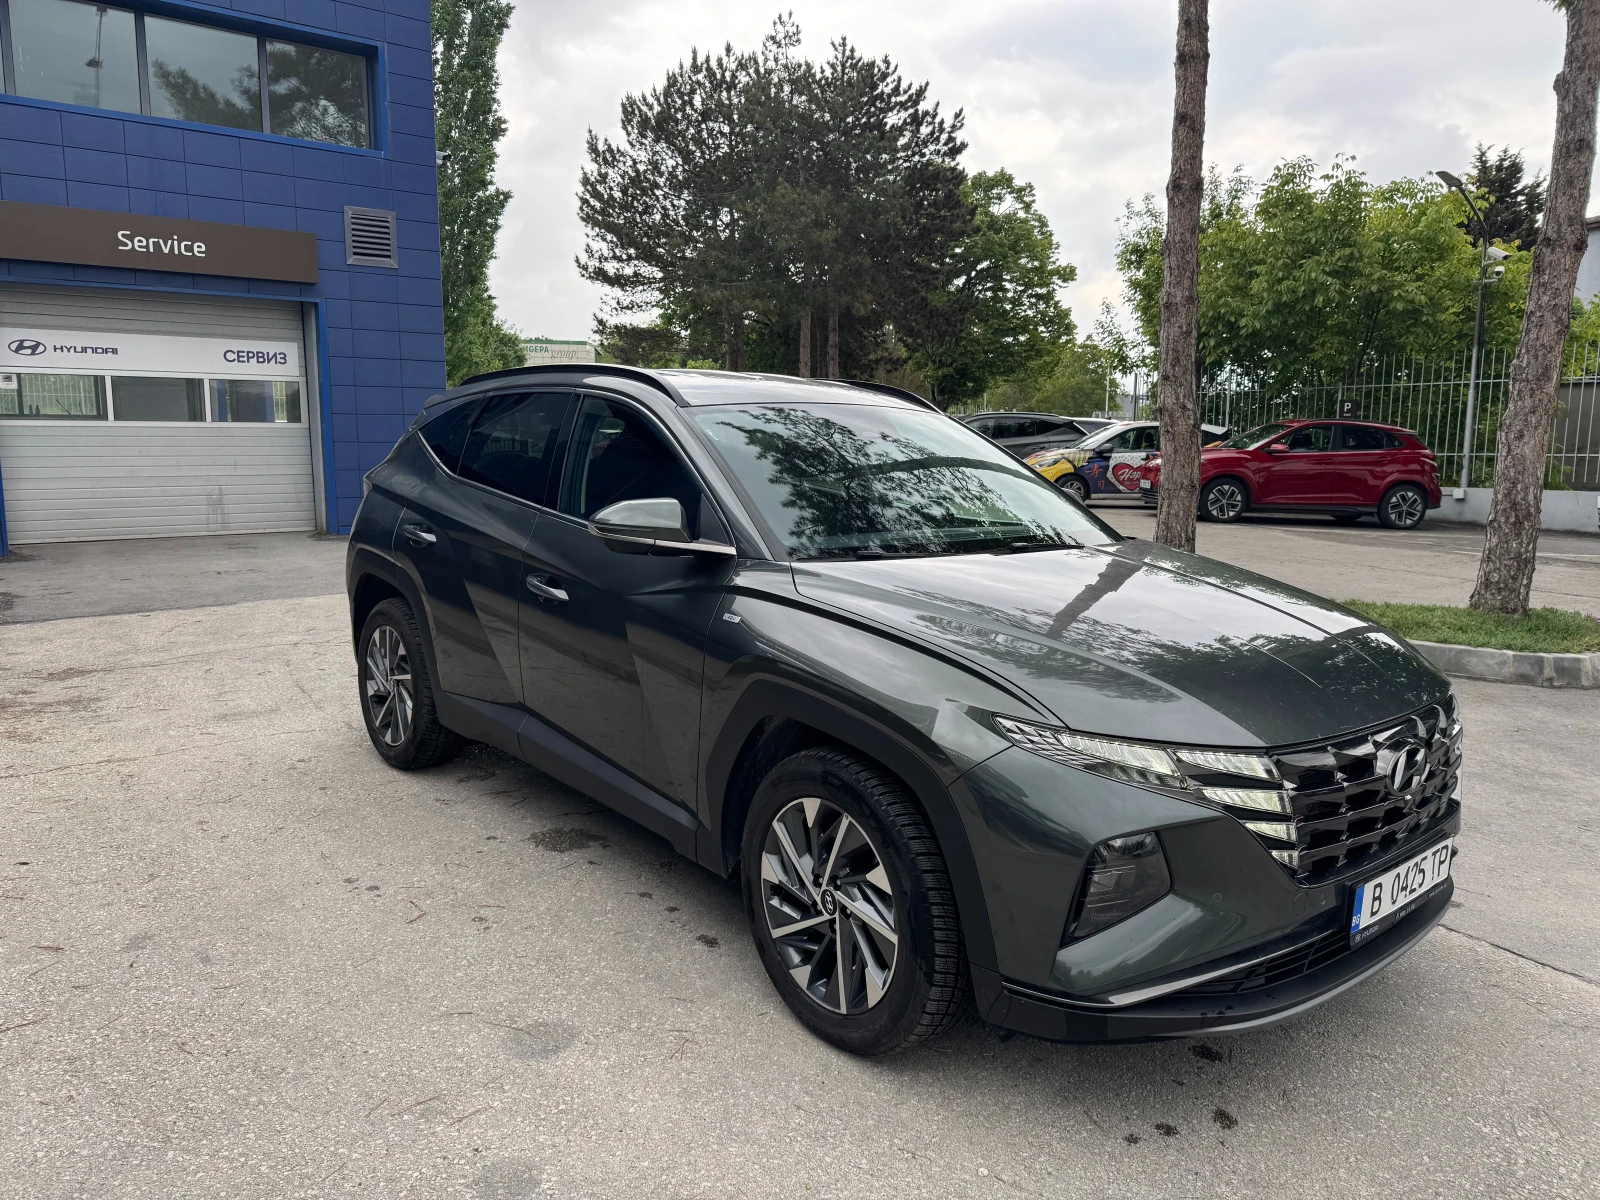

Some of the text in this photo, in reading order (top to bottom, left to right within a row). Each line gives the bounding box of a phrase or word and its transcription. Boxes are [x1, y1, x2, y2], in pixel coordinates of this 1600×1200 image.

[117, 230, 206, 257] Service
[53, 345, 118, 355] HYUNDAI
[223, 349, 288, 365] СЕРВИЗ
[1344, 402, 1351, 412] P
[1118, 468, 1141, 481] Hap
[1370, 881, 1383, 918] B
[1391, 854, 1428, 905] 0425
[1431, 844, 1449, 881] TP
[1351, 914, 1361, 927] BG
